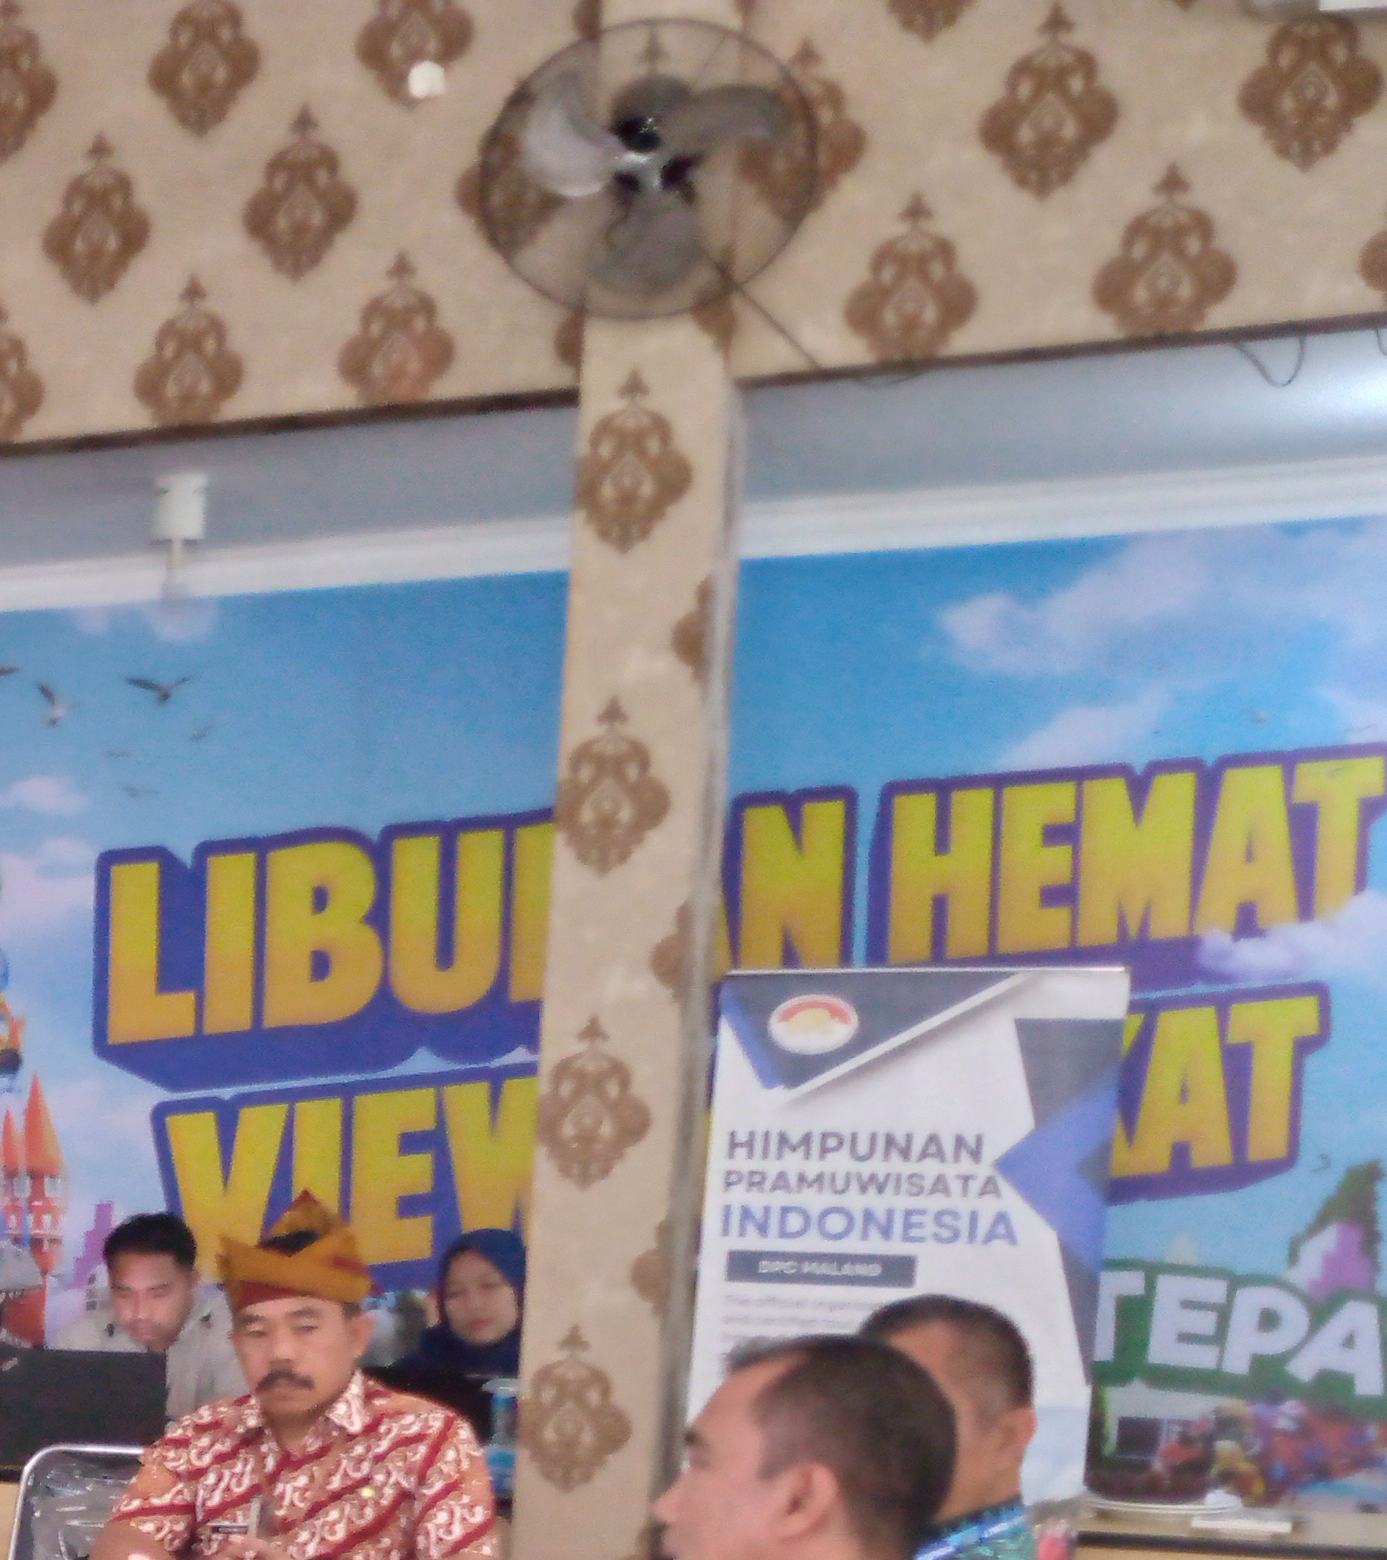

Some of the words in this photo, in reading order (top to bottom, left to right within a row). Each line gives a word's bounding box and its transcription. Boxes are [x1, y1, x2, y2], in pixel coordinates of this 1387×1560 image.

[883, 752, 1387, 965] HEMAT
[727, 1130, 985, 1164] HIMPUNAN
[723, 1170, 1002, 1198] PRAMUWISATA
[721, 1204, 1019, 1245] INDONESIA
